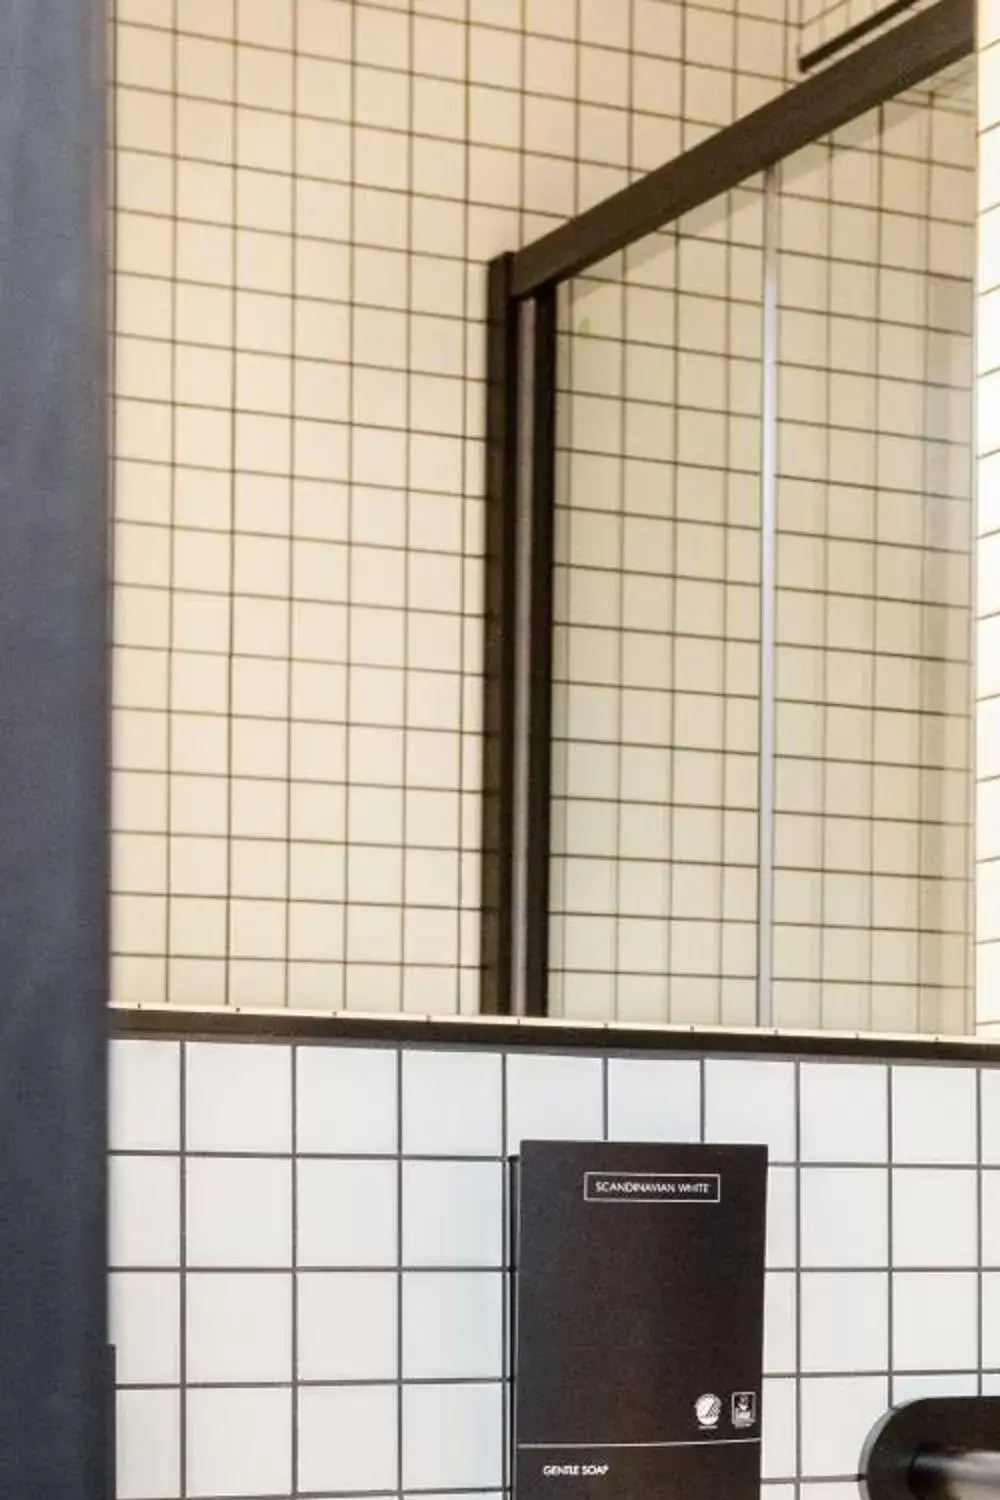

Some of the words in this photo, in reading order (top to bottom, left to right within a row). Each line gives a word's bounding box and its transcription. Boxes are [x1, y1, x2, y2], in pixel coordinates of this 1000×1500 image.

[595, 1181, 675, 1193] SCANDINAVIAN
[678, 1183, 710, 1193] WHITE
[543, 1465, 579, 1476] GENTLE
[581, 1465, 608, 1475] SOAP
